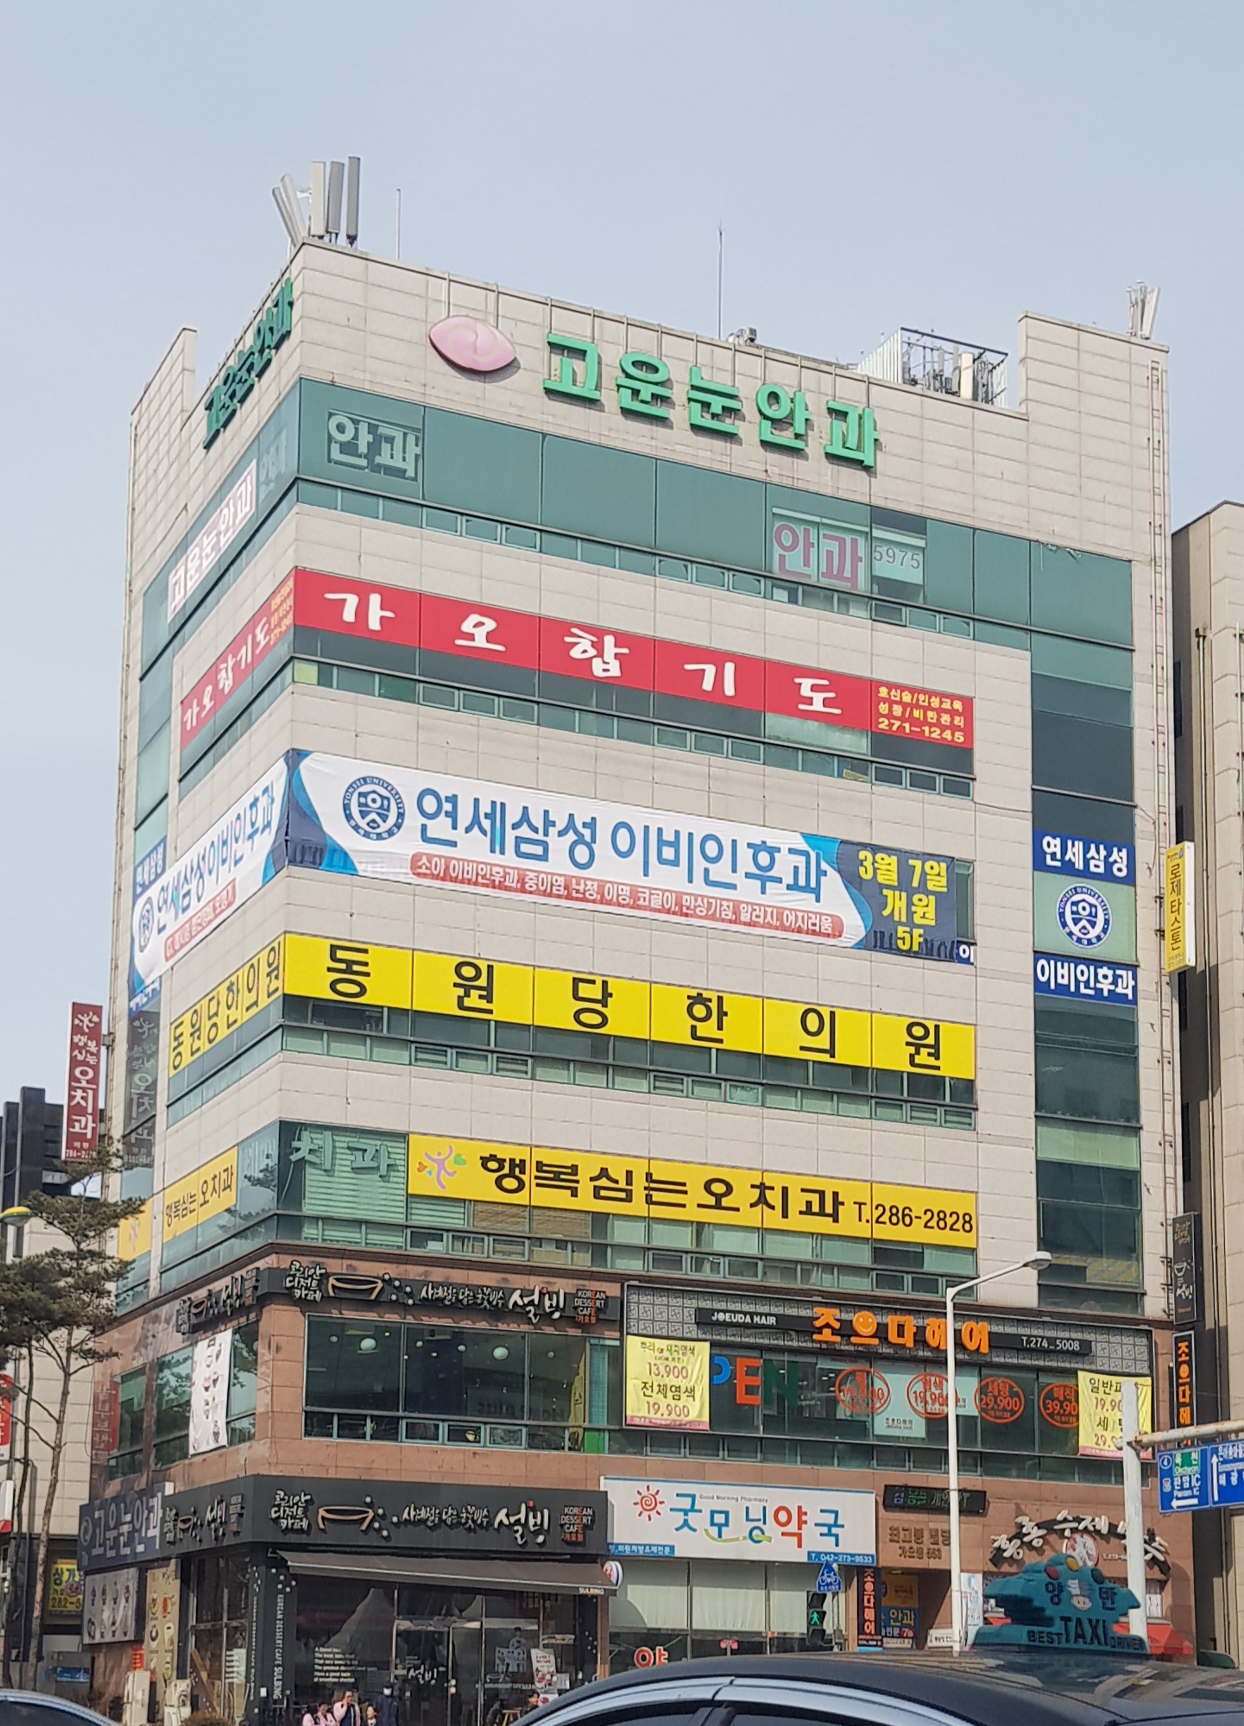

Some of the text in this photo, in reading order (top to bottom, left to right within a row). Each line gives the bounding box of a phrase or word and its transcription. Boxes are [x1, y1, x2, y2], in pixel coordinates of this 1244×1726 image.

[543, 332, 879, 468] 고운눈안과
[328, 413, 423, 480] 안과
[170, 475, 253, 611] 고운눈안과
[774, 523, 863, 590] 안과
[873, 545, 921, 570] 5975
[878, 718, 965, 743] 271-1245
[344, 777, 404, 813] YONSEI UNIVERSITY
[859, 850, 948, 893] 3월 7일
[1042, 835, 1128, 878] 연세삼성
[417, 856, 446, 878] 소아
[783, 910, 833, 935] 어지러움
[882, 888, 936, 927] 개원
[896, 926, 924, 953] 5F
[1036, 958, 1136, 1000] 이비인후과
[69, 1066, 97, 1140] 오치과
[290, 1129, 397, 1178] 치과
[200, 1164, 234, 1208] 오치과
[853, 1201, 974, 1235] T.286-2828
[293, 1288, 322, 1303] 카페
[508, 1285, 566, 1324] 설빙
[574, 1297, 605, 1308] DESSERT
[577, 1290, 606, 1300] KOREAN
[578, 1306, 597, 1316] CAFE
[711, 1311, 777, 1326] JOEUDA HAIR
[641, 1380, 696, 1402] 전체염색
[274, 1490, 312, 1506] 코리안
[564, 1506, 593, 1515] KOREAN
[699, 1493, 769, 1504] Good Morning Pharmacy
[91, 1491, 163, 1558] 고운눈안과
[280, 1518, 309, 1530] 카페
[494, 1503, 549, 1545] 설빙
[561, 1515, 592, 1525] DESSERT
[564, 1524, 583, 1533] CAFE
[669, 1492, 845, 1548] 굿모닝약국
[1053, 1509, 1110, 1538] 수제
[864, 1568, 876, 1635] 조으다헤어
[889, 1608, 915, 1627] 안과
[1026, 1630, 1063, 1645] BEST
[1059, 1615, 1109, 1646] TAXI
[273, 1666, 283, 1700] SULBING
[408, 1664, 438, 1685] 설빙
